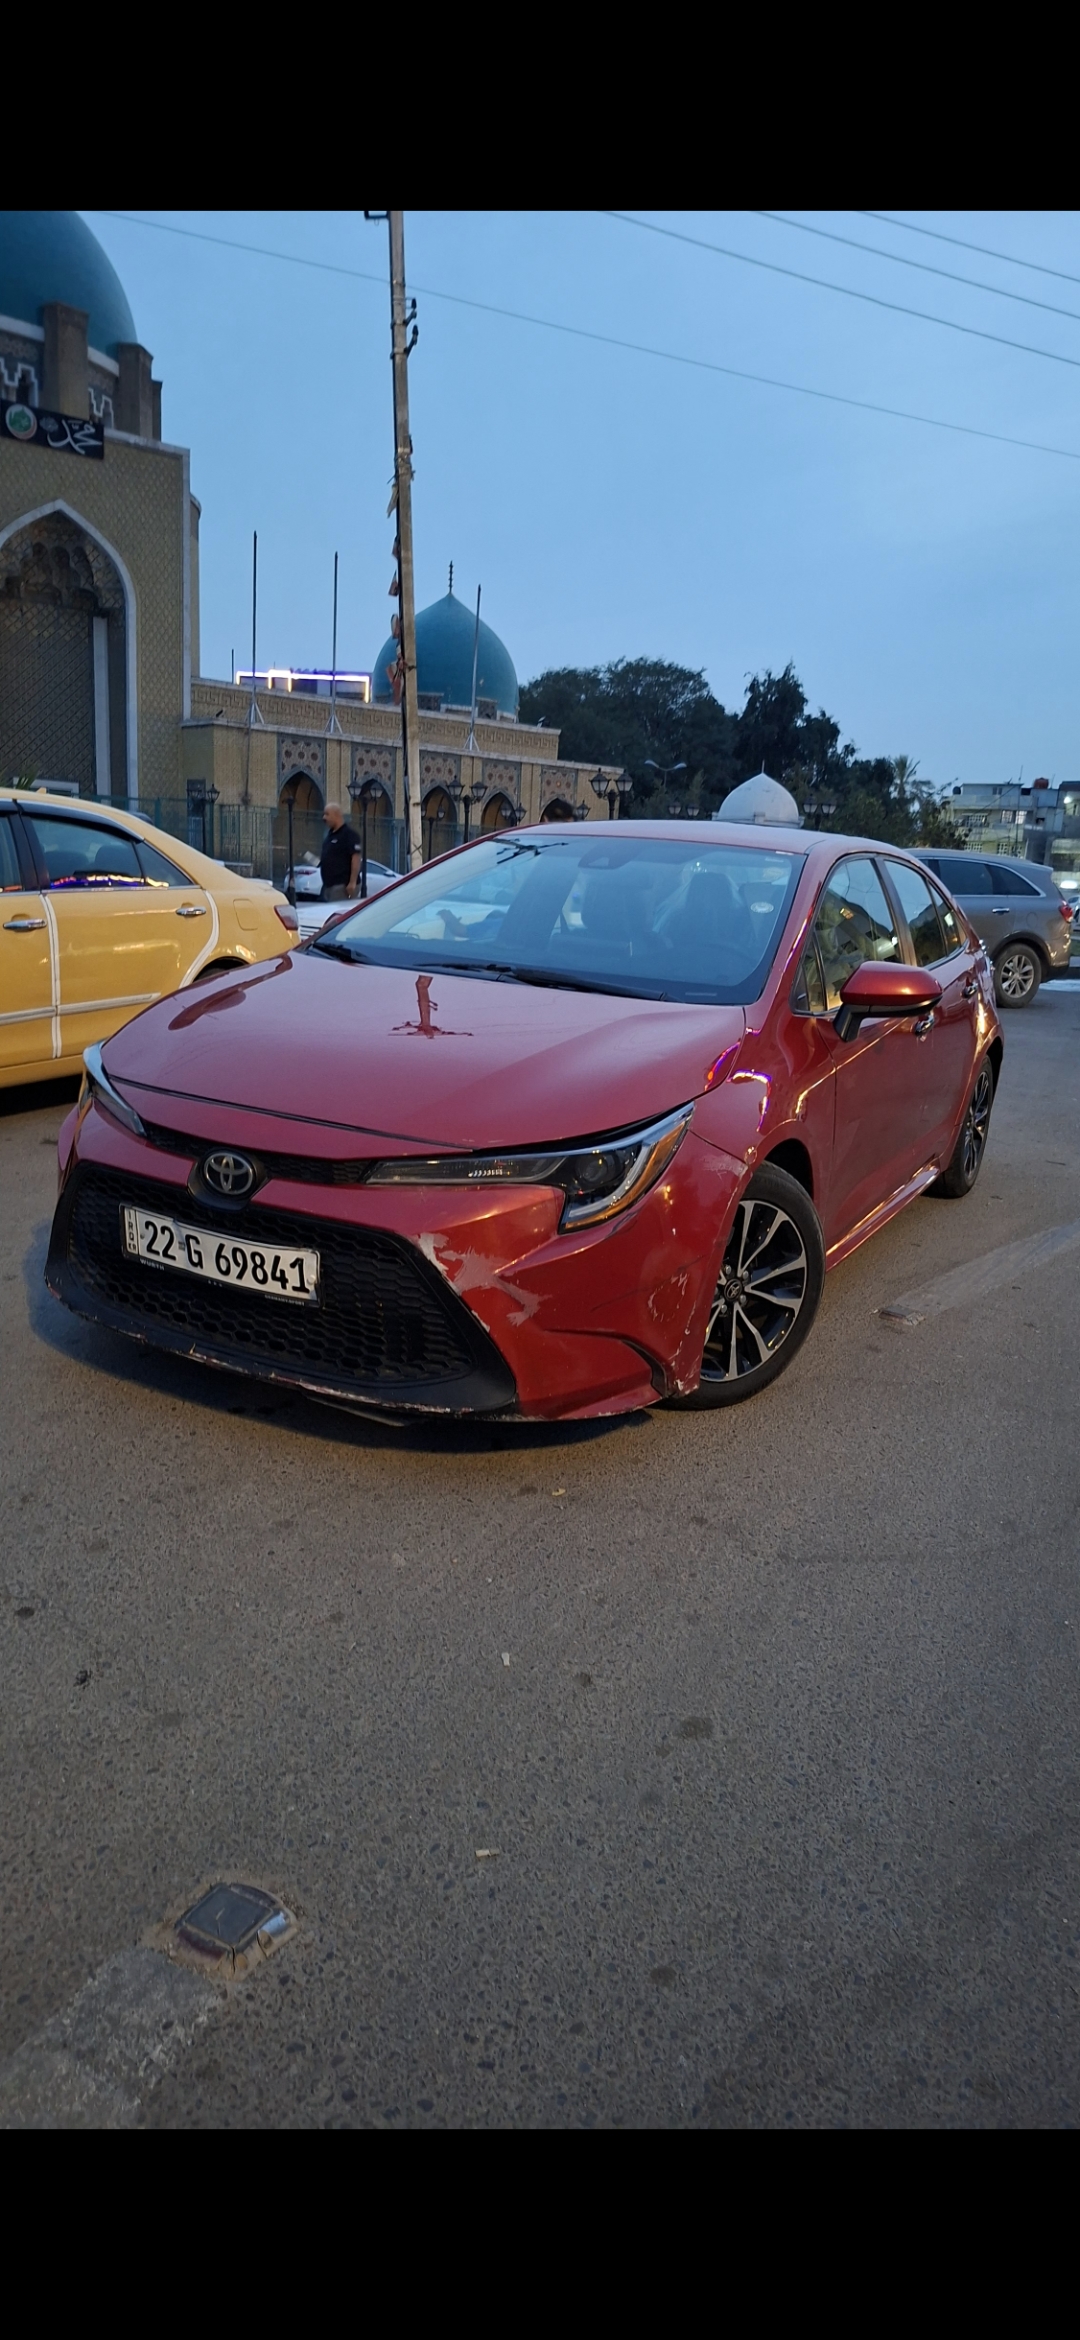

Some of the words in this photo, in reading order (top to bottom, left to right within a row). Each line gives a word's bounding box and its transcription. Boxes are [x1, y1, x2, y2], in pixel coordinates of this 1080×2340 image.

[144, 1220, 177, 1261] 22
[184, 1234, 204, 1270] G
[214, 1243, 310, 1294] 69841
